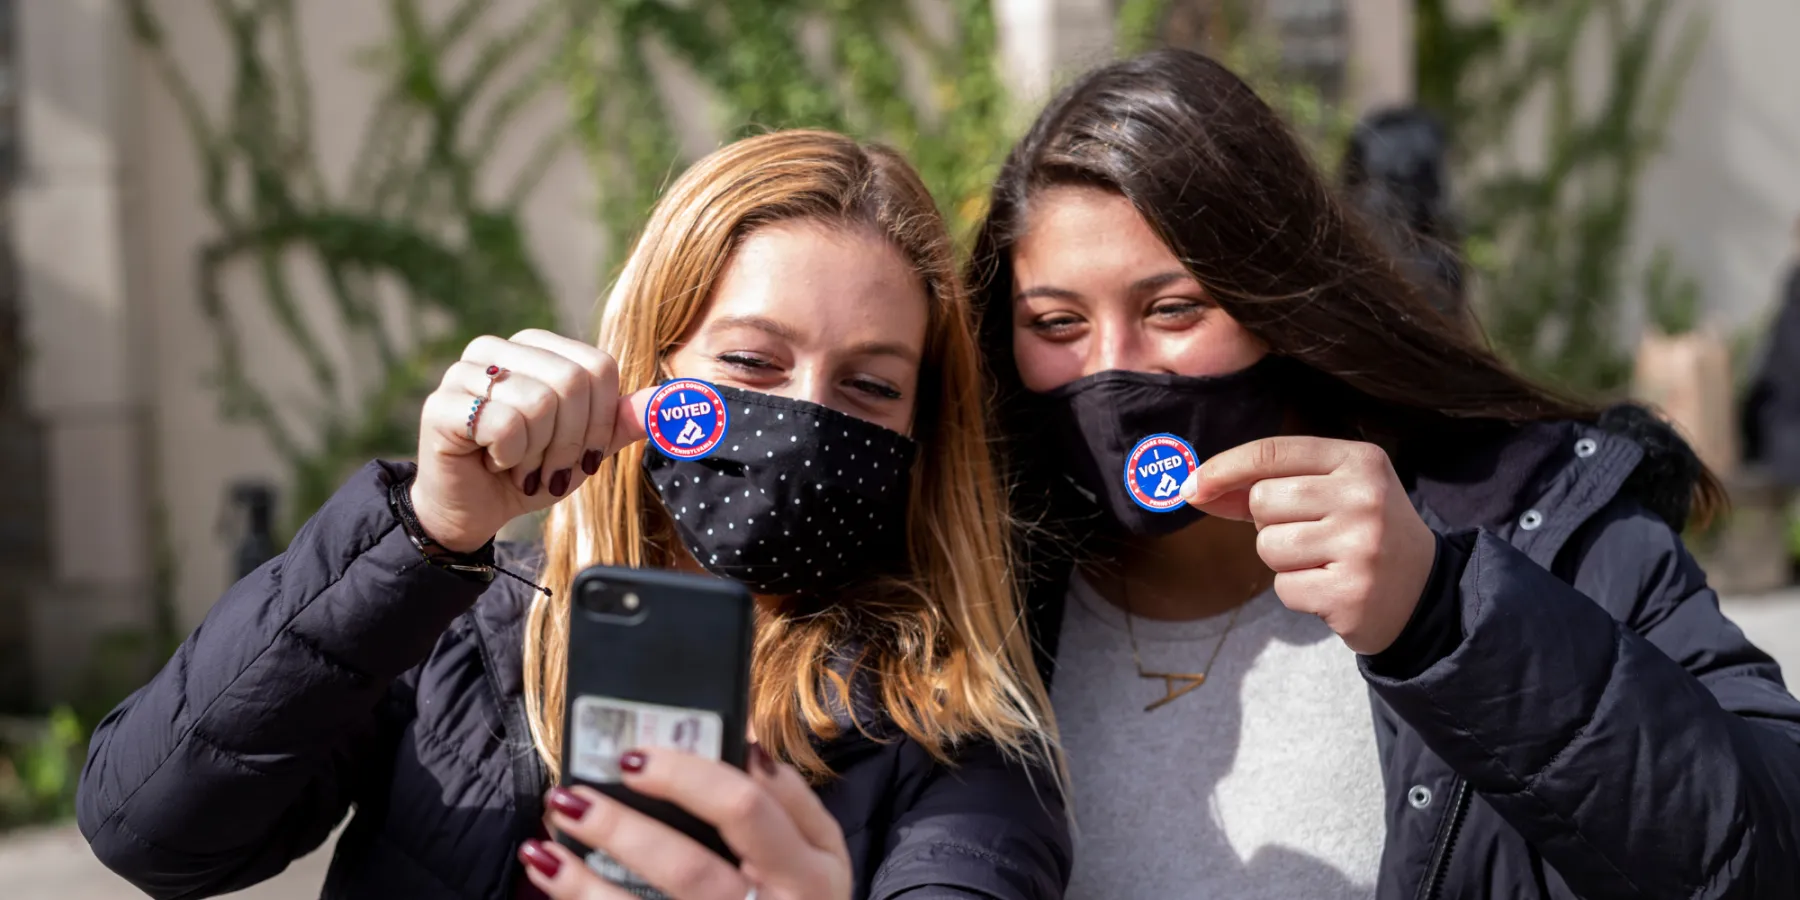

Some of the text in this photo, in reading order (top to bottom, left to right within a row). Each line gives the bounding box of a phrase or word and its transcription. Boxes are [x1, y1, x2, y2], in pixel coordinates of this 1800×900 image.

[656, 383, 709, 402] DELAWARE COUNTY
[679, 392, 686, 404] I
[661, 402, 711, 422] VOTED
[670, 440, 713, 455] PENNSYLVANIA
[1133, 439, 1179, 460] DELAWARE COUNTY
[1153, 449, 1160, 460] I
[1138, 455, 1183, 478] VOTED
[1149, 494, 1183, 507] PENNSYLVA
